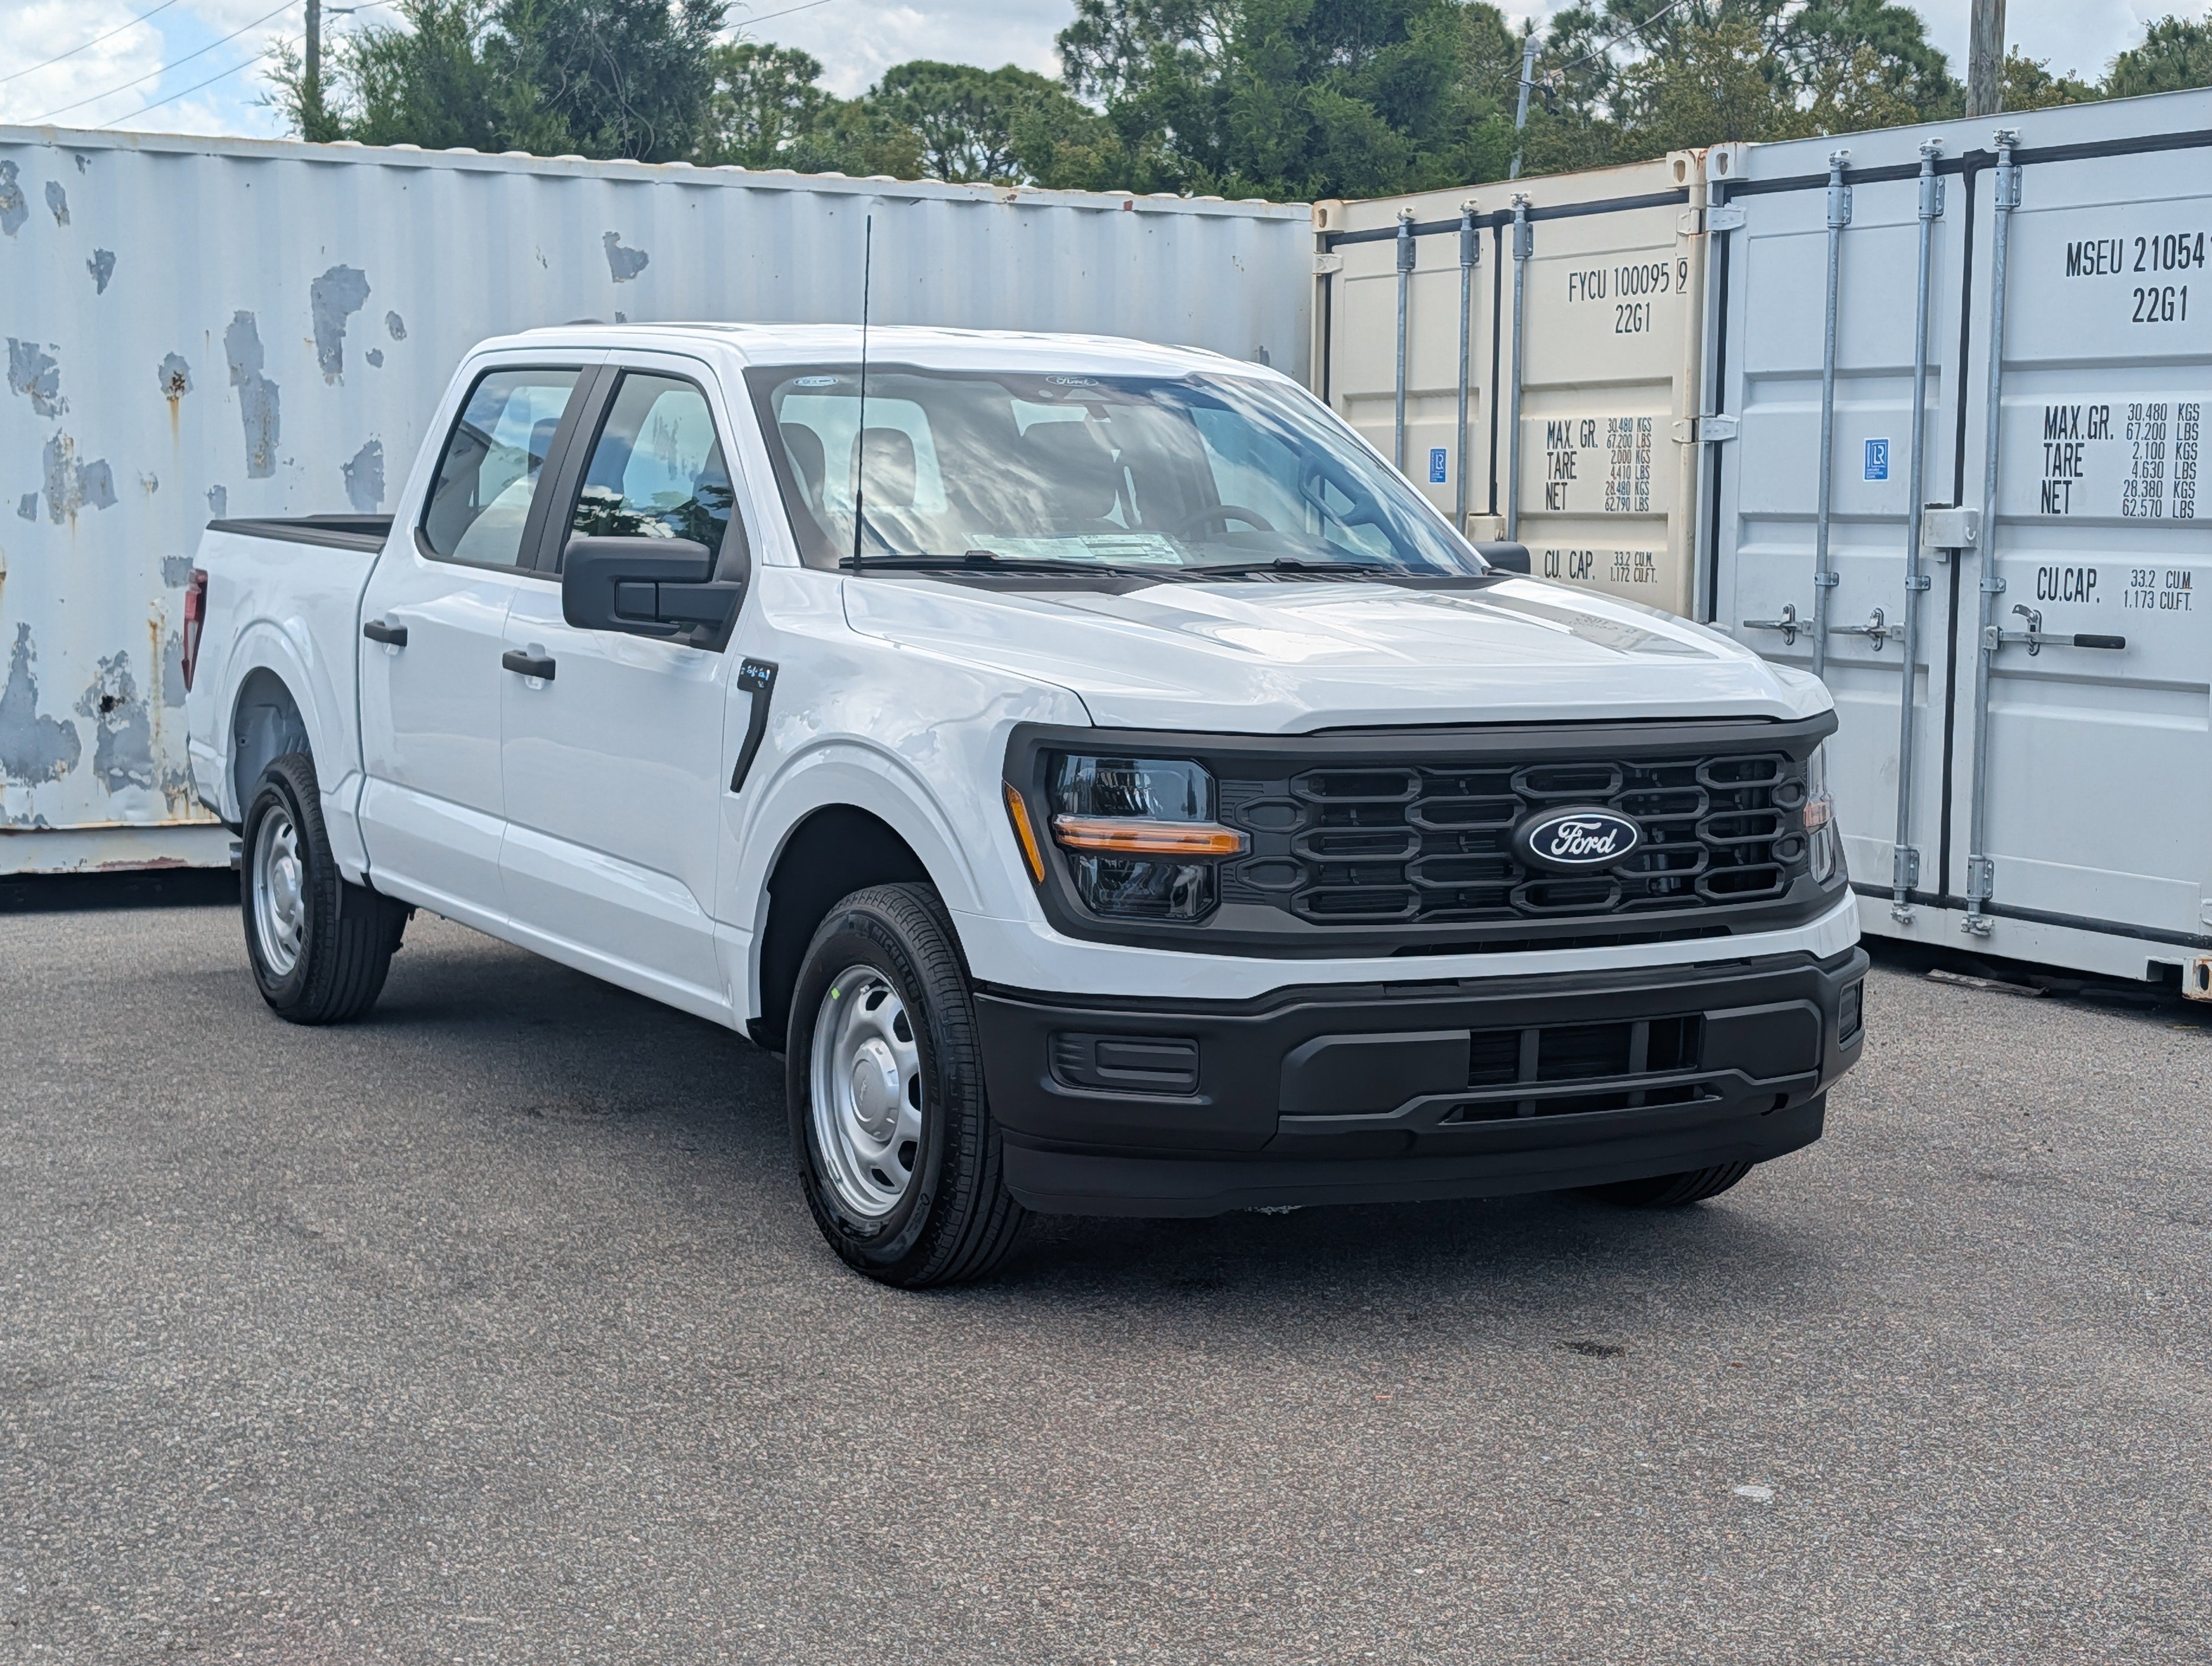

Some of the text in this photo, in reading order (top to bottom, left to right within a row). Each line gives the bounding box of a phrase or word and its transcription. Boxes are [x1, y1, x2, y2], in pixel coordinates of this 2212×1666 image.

[2066, 232, 2212, 277] MSEU 21054
[1569, 260, 1688, 302] FYCU 100095 9
[1615, 302, 1650, 334] 22G1
[2132, 285, 2187, 322] 22G1
[2177, 403, 2200, 421] KGS
[1547, 419, 1573, 450] MAX.
[1580, 419, 1598, 448] GR.
[1637, 417, 1652, 432] KGS
[1636, 433, 1651, 448] LBS
[2176, 422, 2199, 441] LBS
[1547, 451, 1577, 479] TARE
[1635, 449, 1651, 464] KGS
[1635, 465, 1650, 480] LBS
[2043, 443, 2085, 477] TARE
[2175, 441, 2198, 460] KGS
[2174, 461, 2197, 479] LBS
[1546, 482, 1568, 510] NET
[1634, 480, 1650, 496] KGS
[1634, 497, 1649, 511] LBS
[2041, 479, 2072, 514] NET
[2173, 480, 2196, 499] KGS
[2172, 499, 2195, 519] LBS
[1544, 550, 1562, 579] CU.
[1569, 550, 1596, 580] CAP.
[2130, 569, 2156, 588] 33.2
[1551, 822, 1618, 855] Ford
